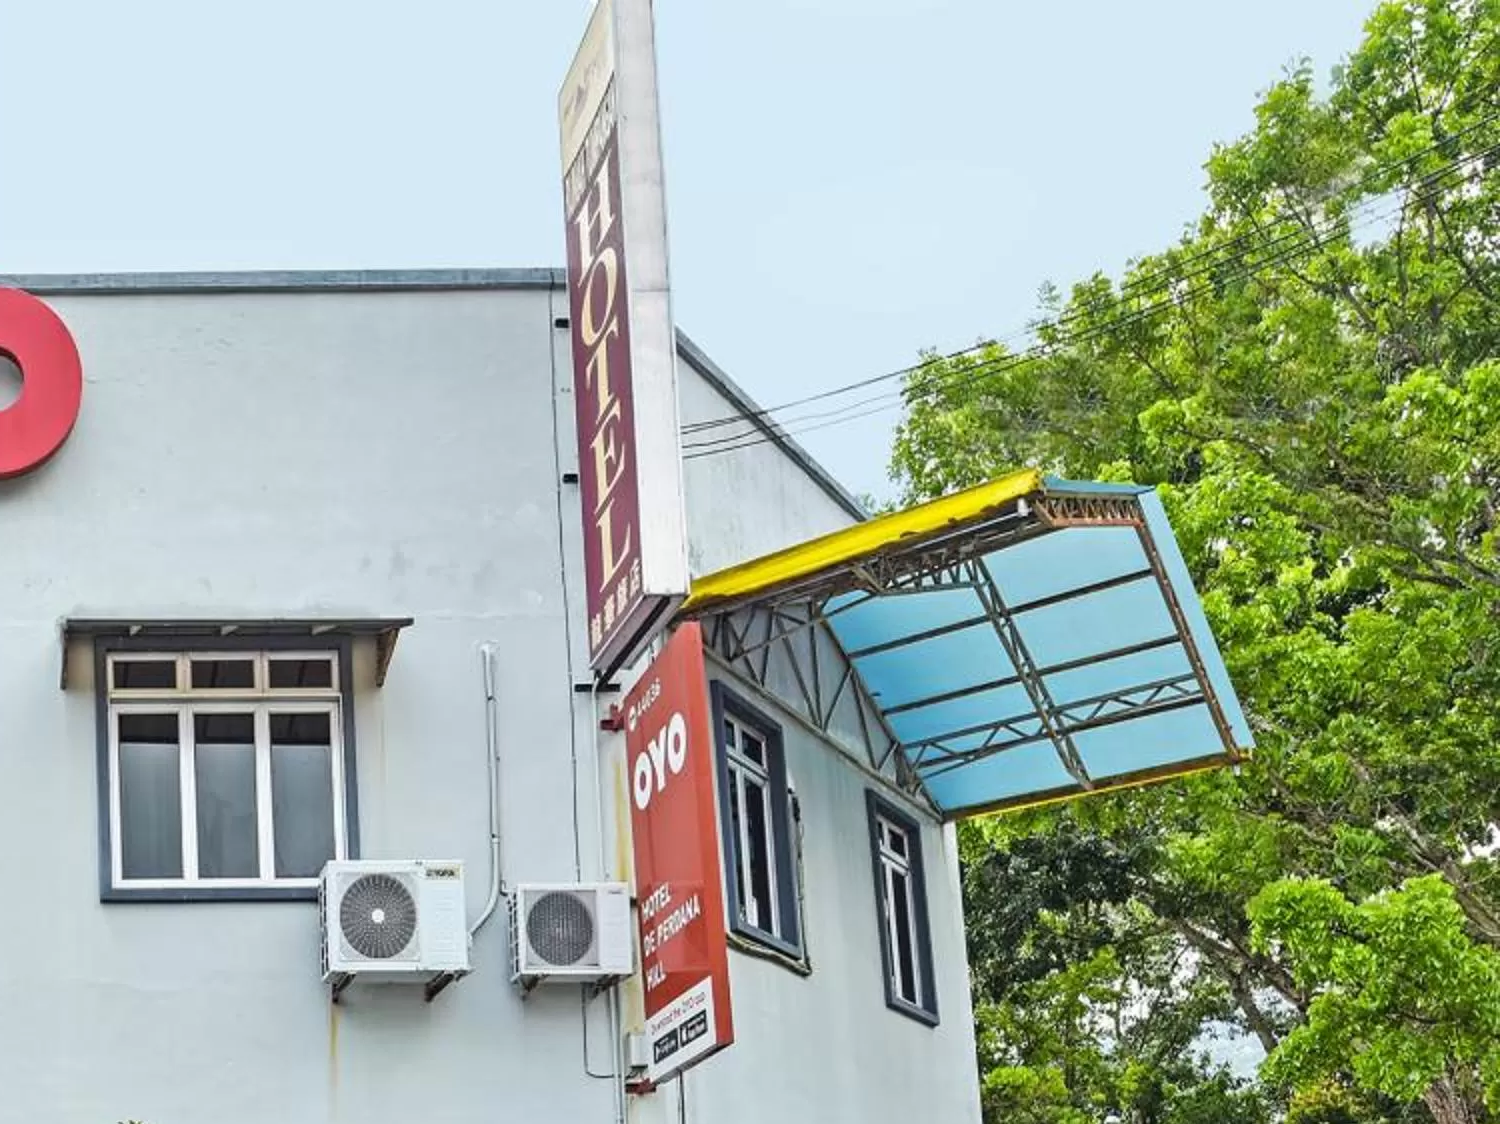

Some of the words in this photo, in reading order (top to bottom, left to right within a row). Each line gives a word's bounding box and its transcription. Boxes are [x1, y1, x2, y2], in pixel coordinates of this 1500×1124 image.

[573, 147, 632, 593] HOTEL
[633, 711, 687, 811] OYO
[641, 881, 671, 924] HOTEL
